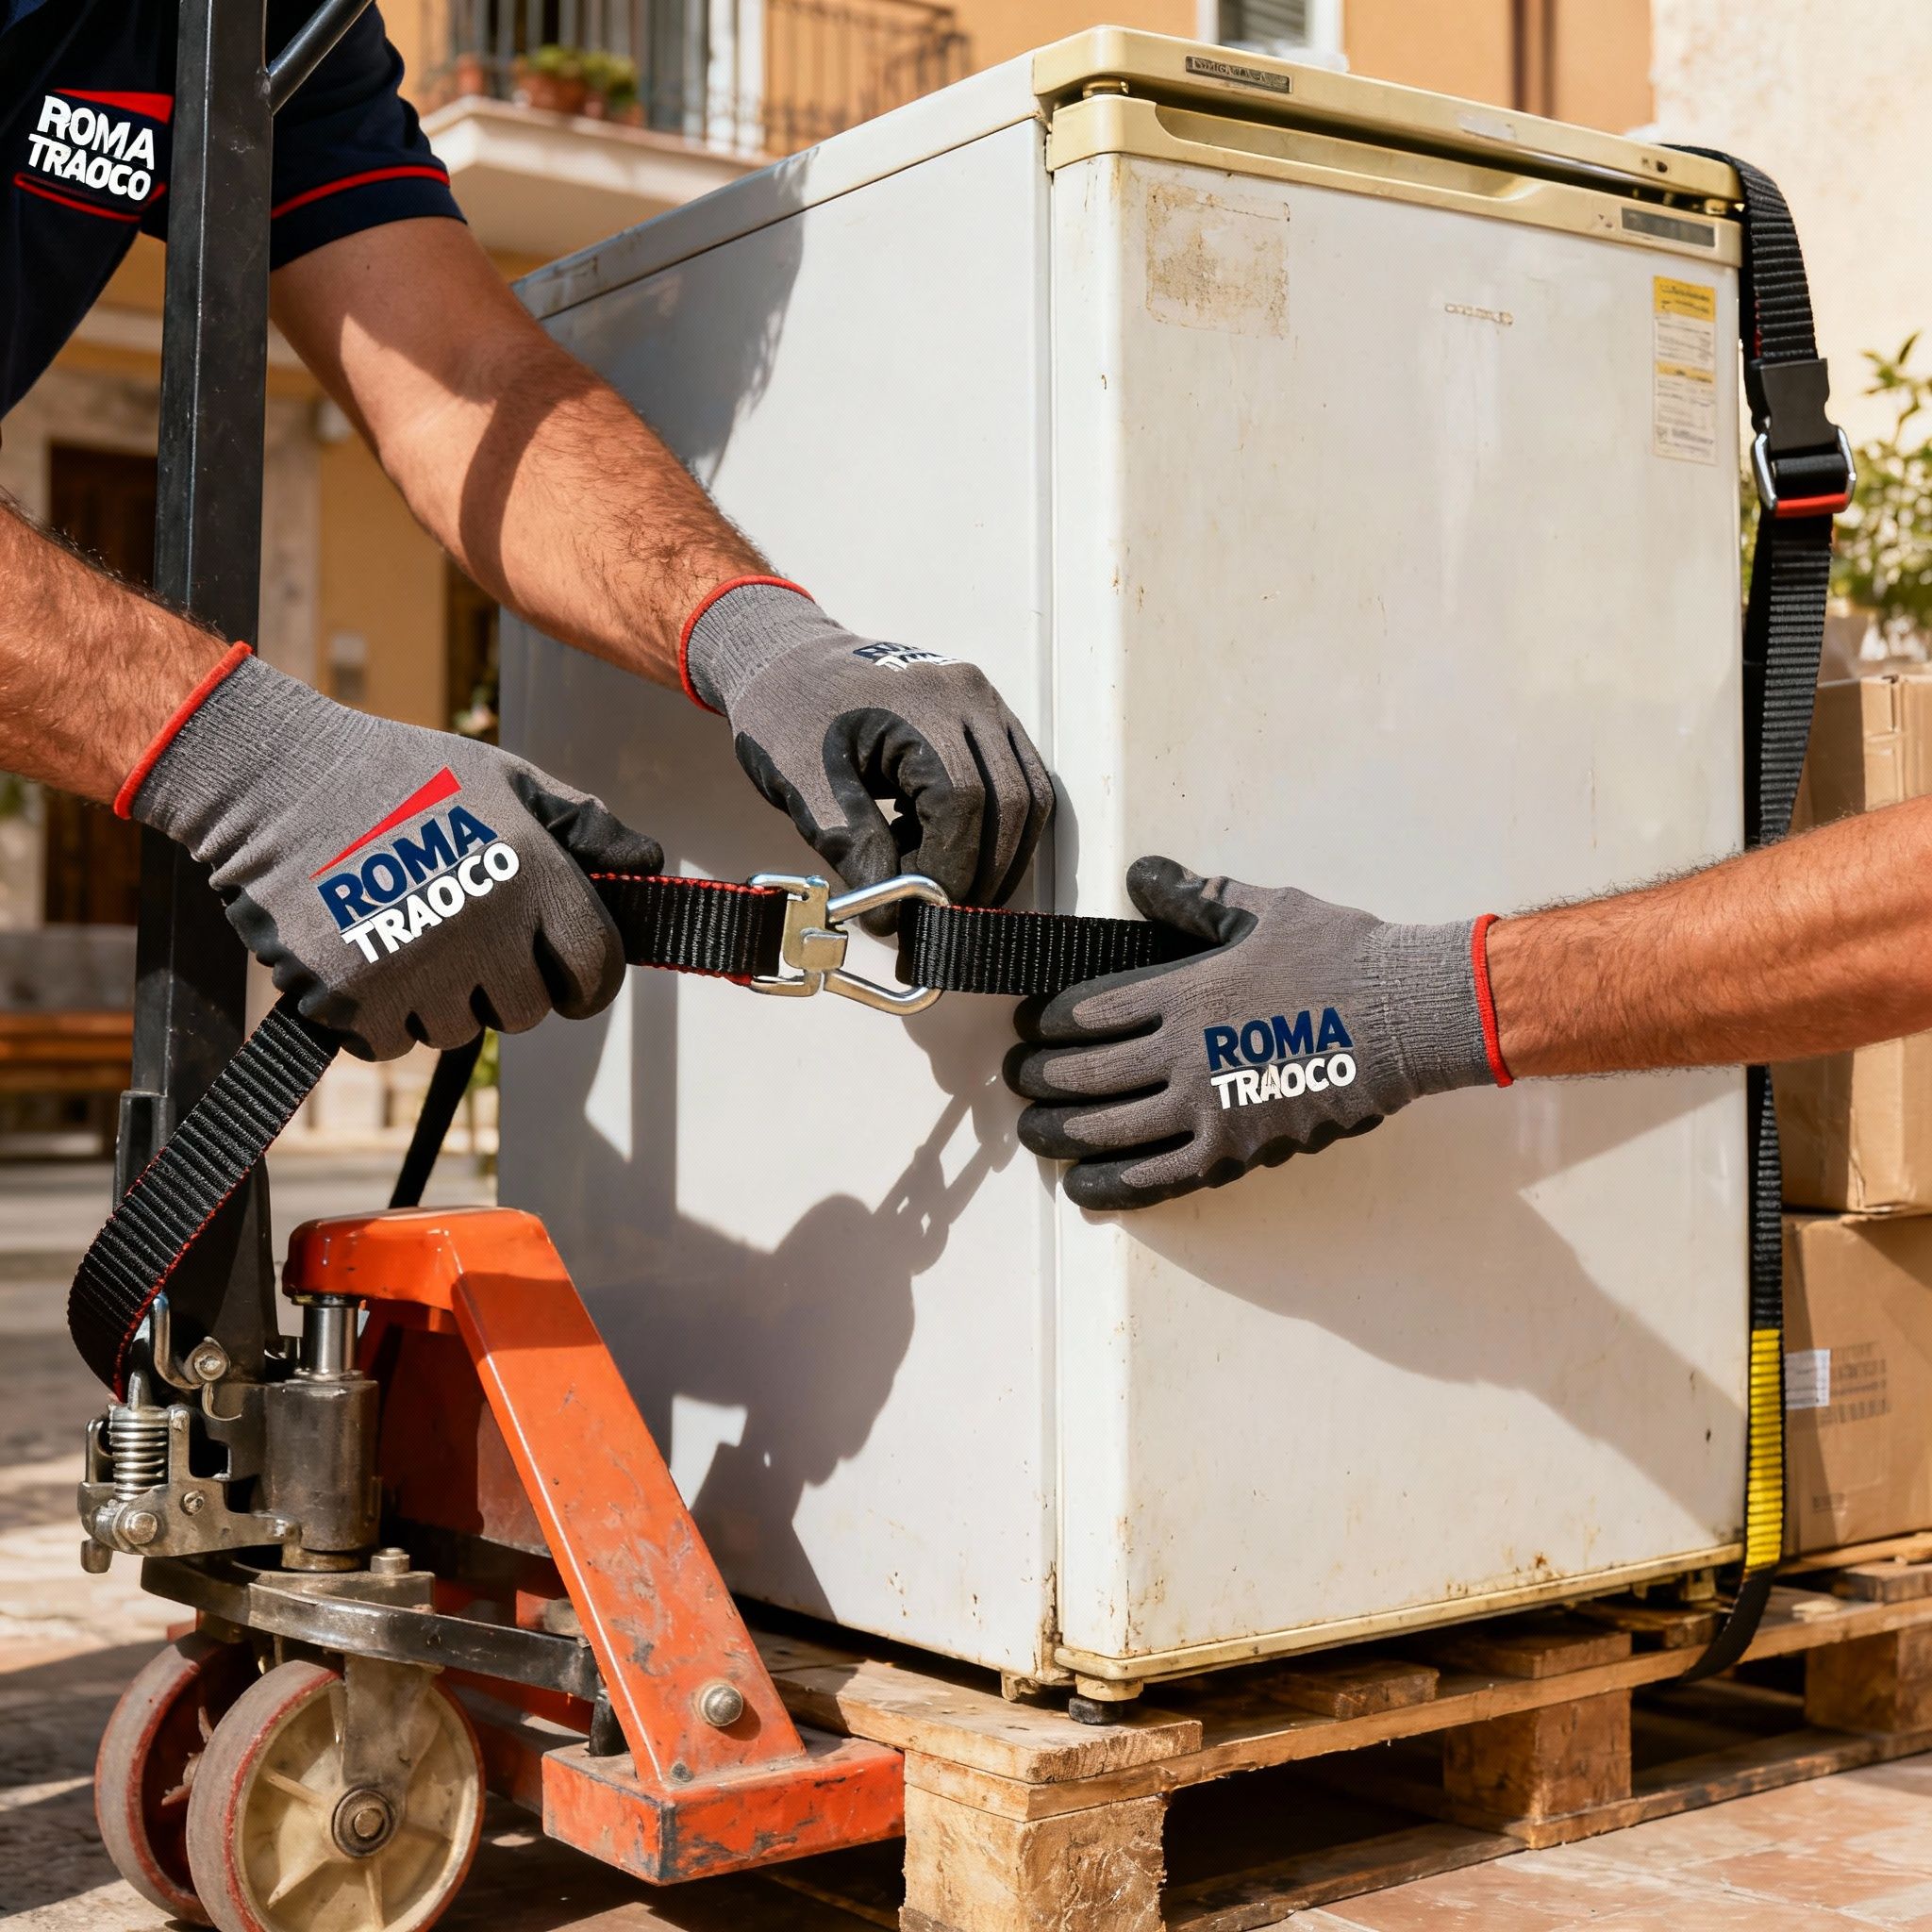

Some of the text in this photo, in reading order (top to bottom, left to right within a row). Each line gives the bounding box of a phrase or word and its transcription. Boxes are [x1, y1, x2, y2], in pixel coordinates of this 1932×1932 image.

[27, 133, 152, 201] TRAOCO
[37, 95, 155, 170] ROMA
[317, 806, 498, 930] ROMA
[341, 842, 520, 964] TRAOCO
[1204, 1007, 1354, 1072] ROMA
[1210, 1053, 1357, 1110] TRAOCO
